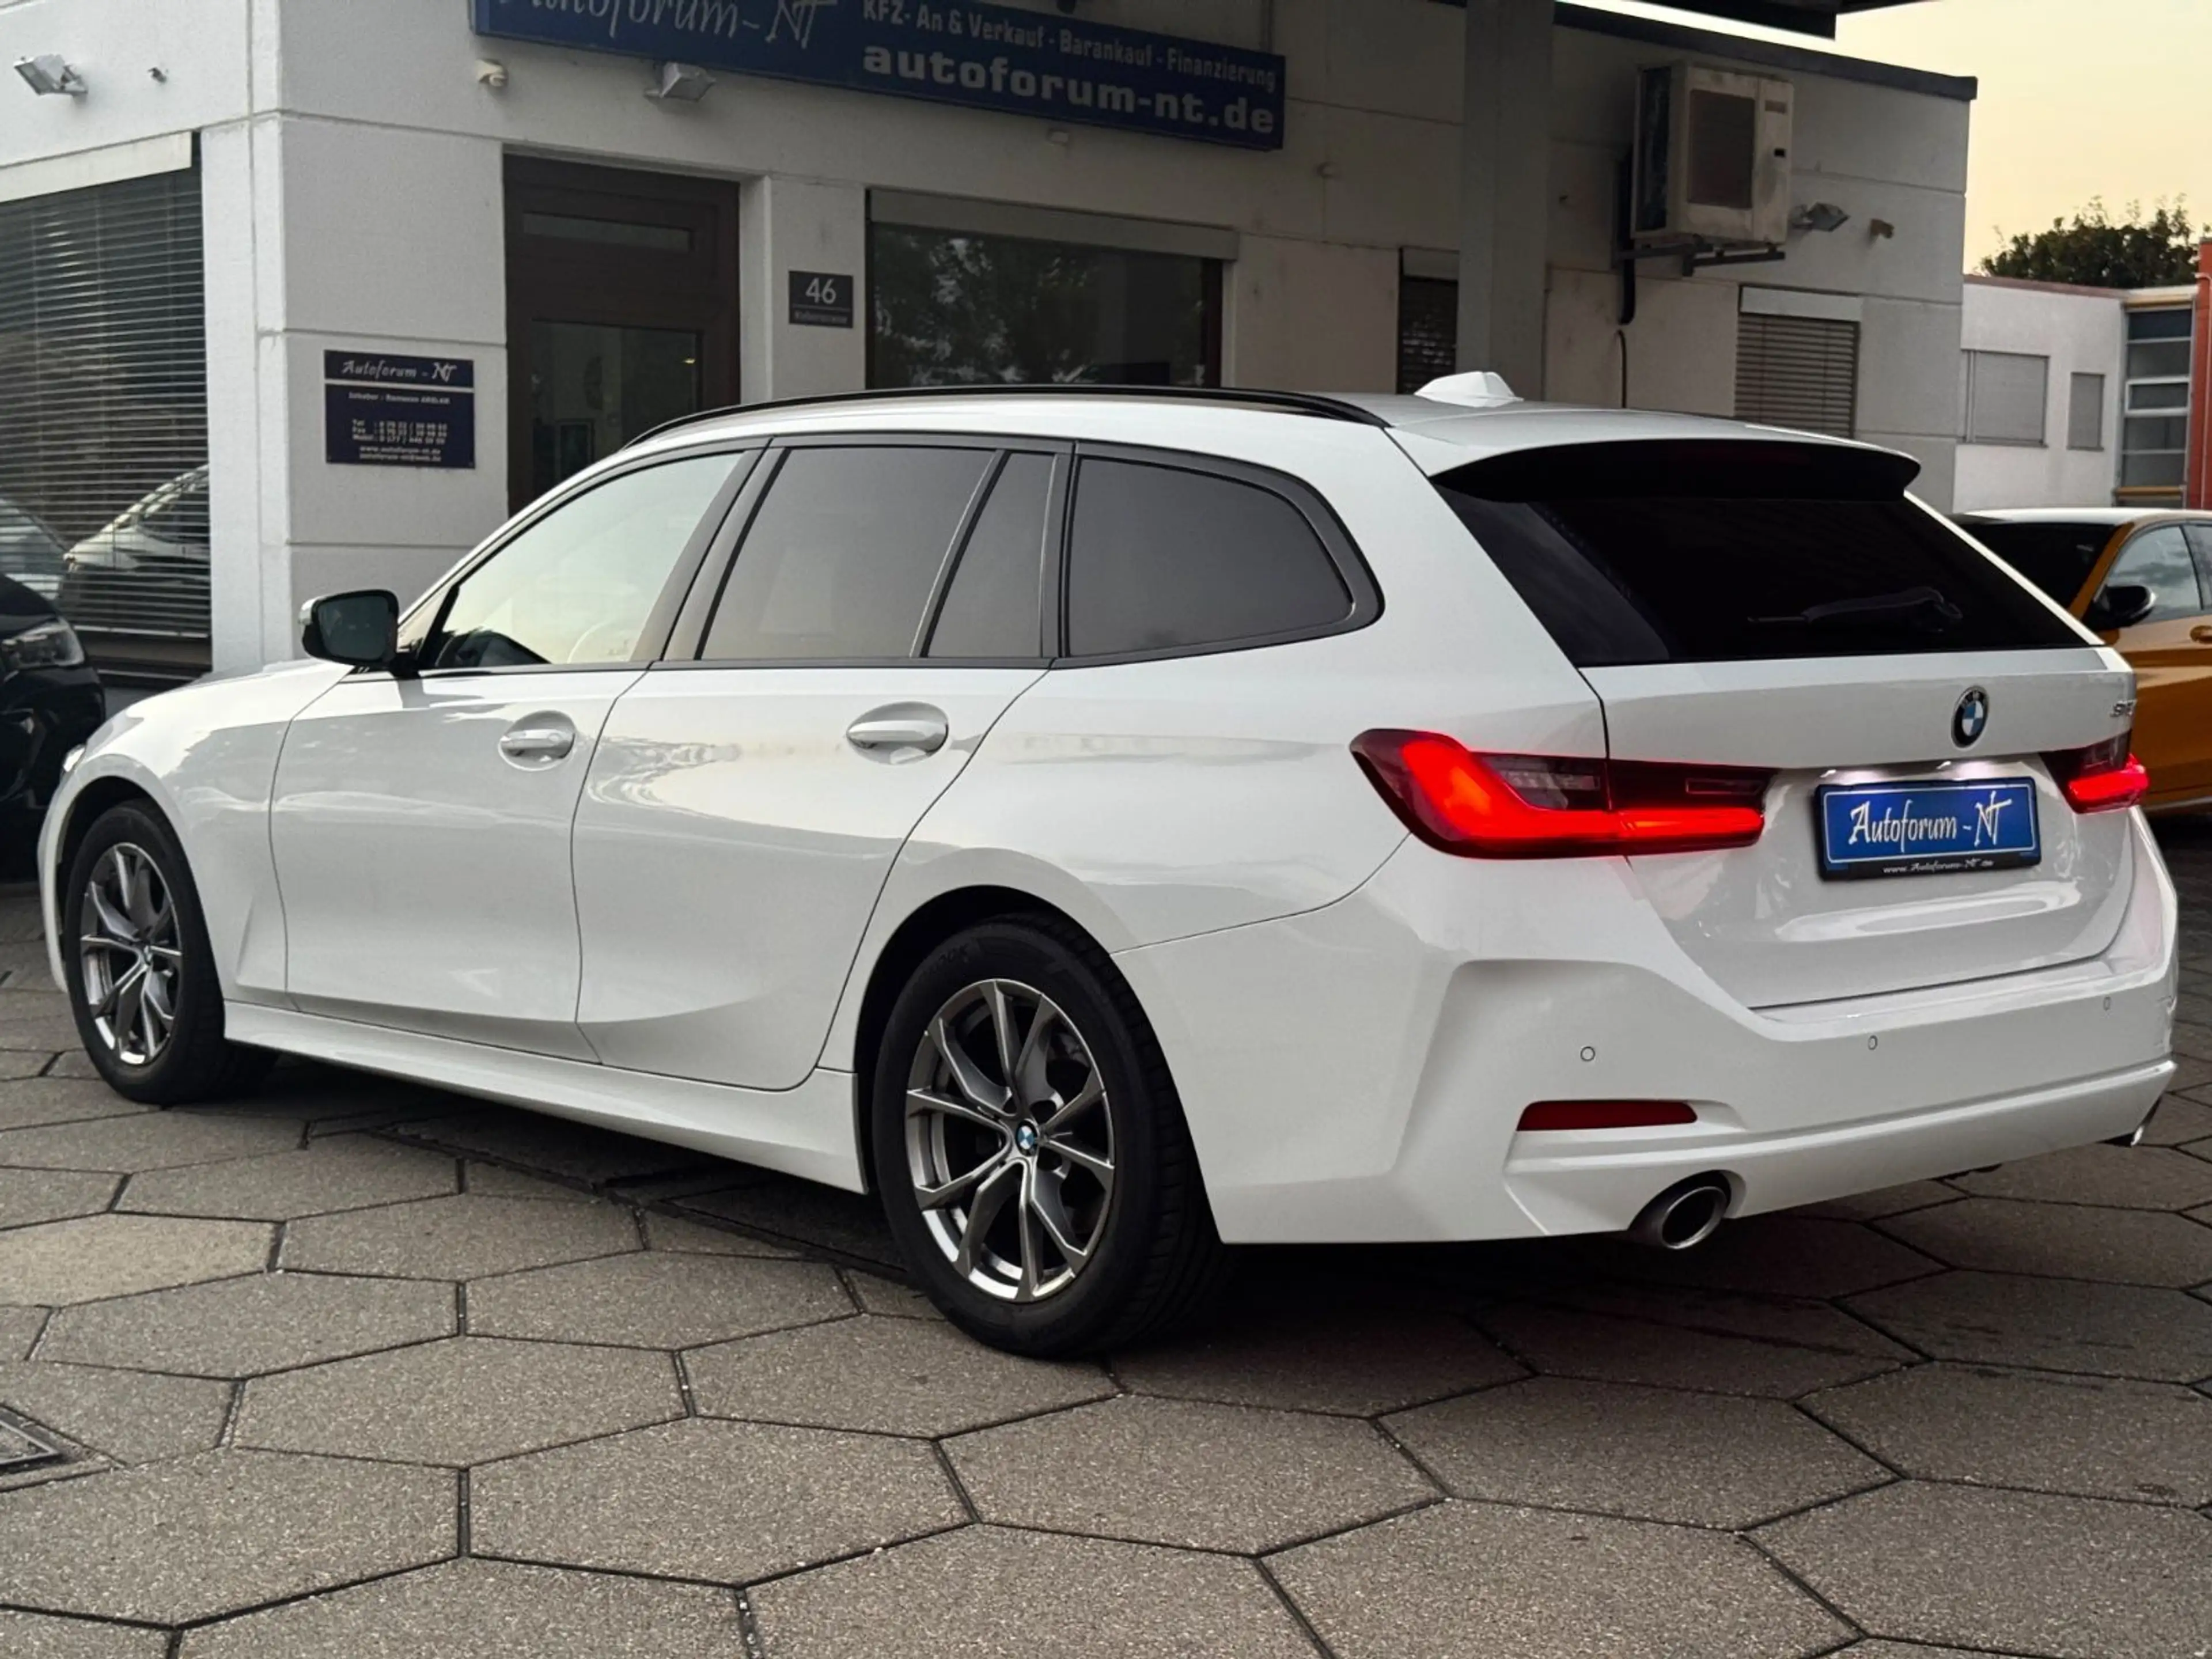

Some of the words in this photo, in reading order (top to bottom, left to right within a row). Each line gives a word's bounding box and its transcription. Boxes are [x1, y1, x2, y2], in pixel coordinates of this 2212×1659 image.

[863, 44, 1274, 134] autoforum-nt.de
[916, 4, 944, 32] An
[949, 9, 963, 35] &
[968, 12, 1046, 48] Verkauf
[1059, 29, 1152, 69] Barankauf
[1166, 47, 1276, 92] Finanzierung
[805, 277, 837, 305] 46
